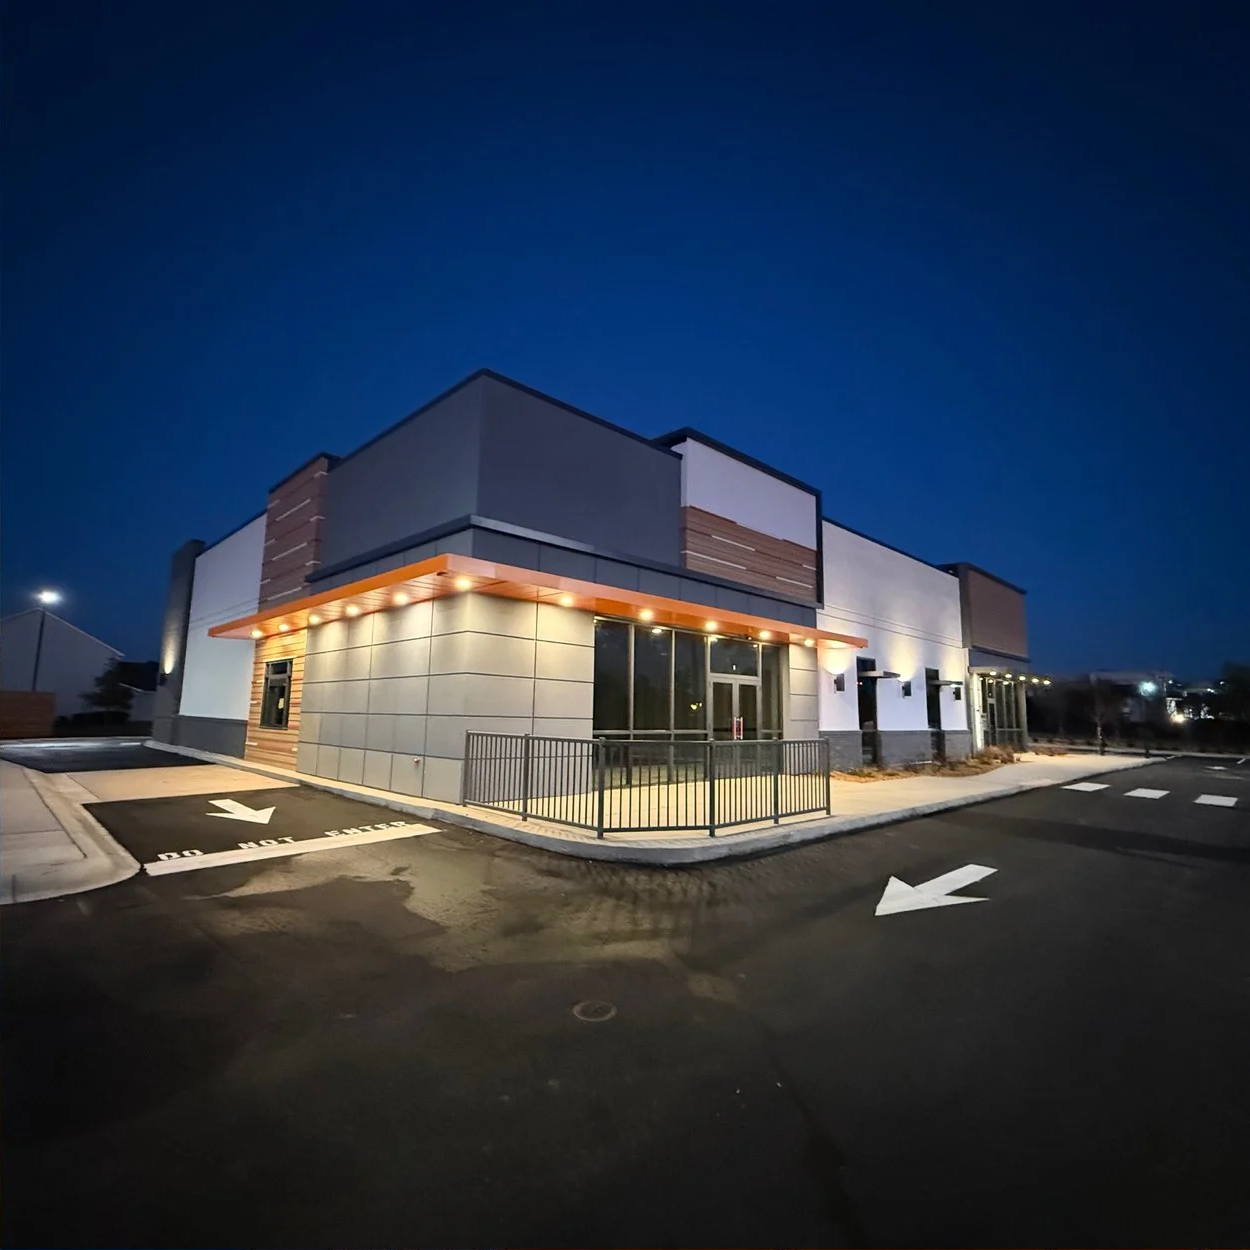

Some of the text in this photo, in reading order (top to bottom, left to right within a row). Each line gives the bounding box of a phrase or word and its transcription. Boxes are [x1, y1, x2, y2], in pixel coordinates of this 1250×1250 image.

[157, 821, 406, 861] DO NOT ENTER
